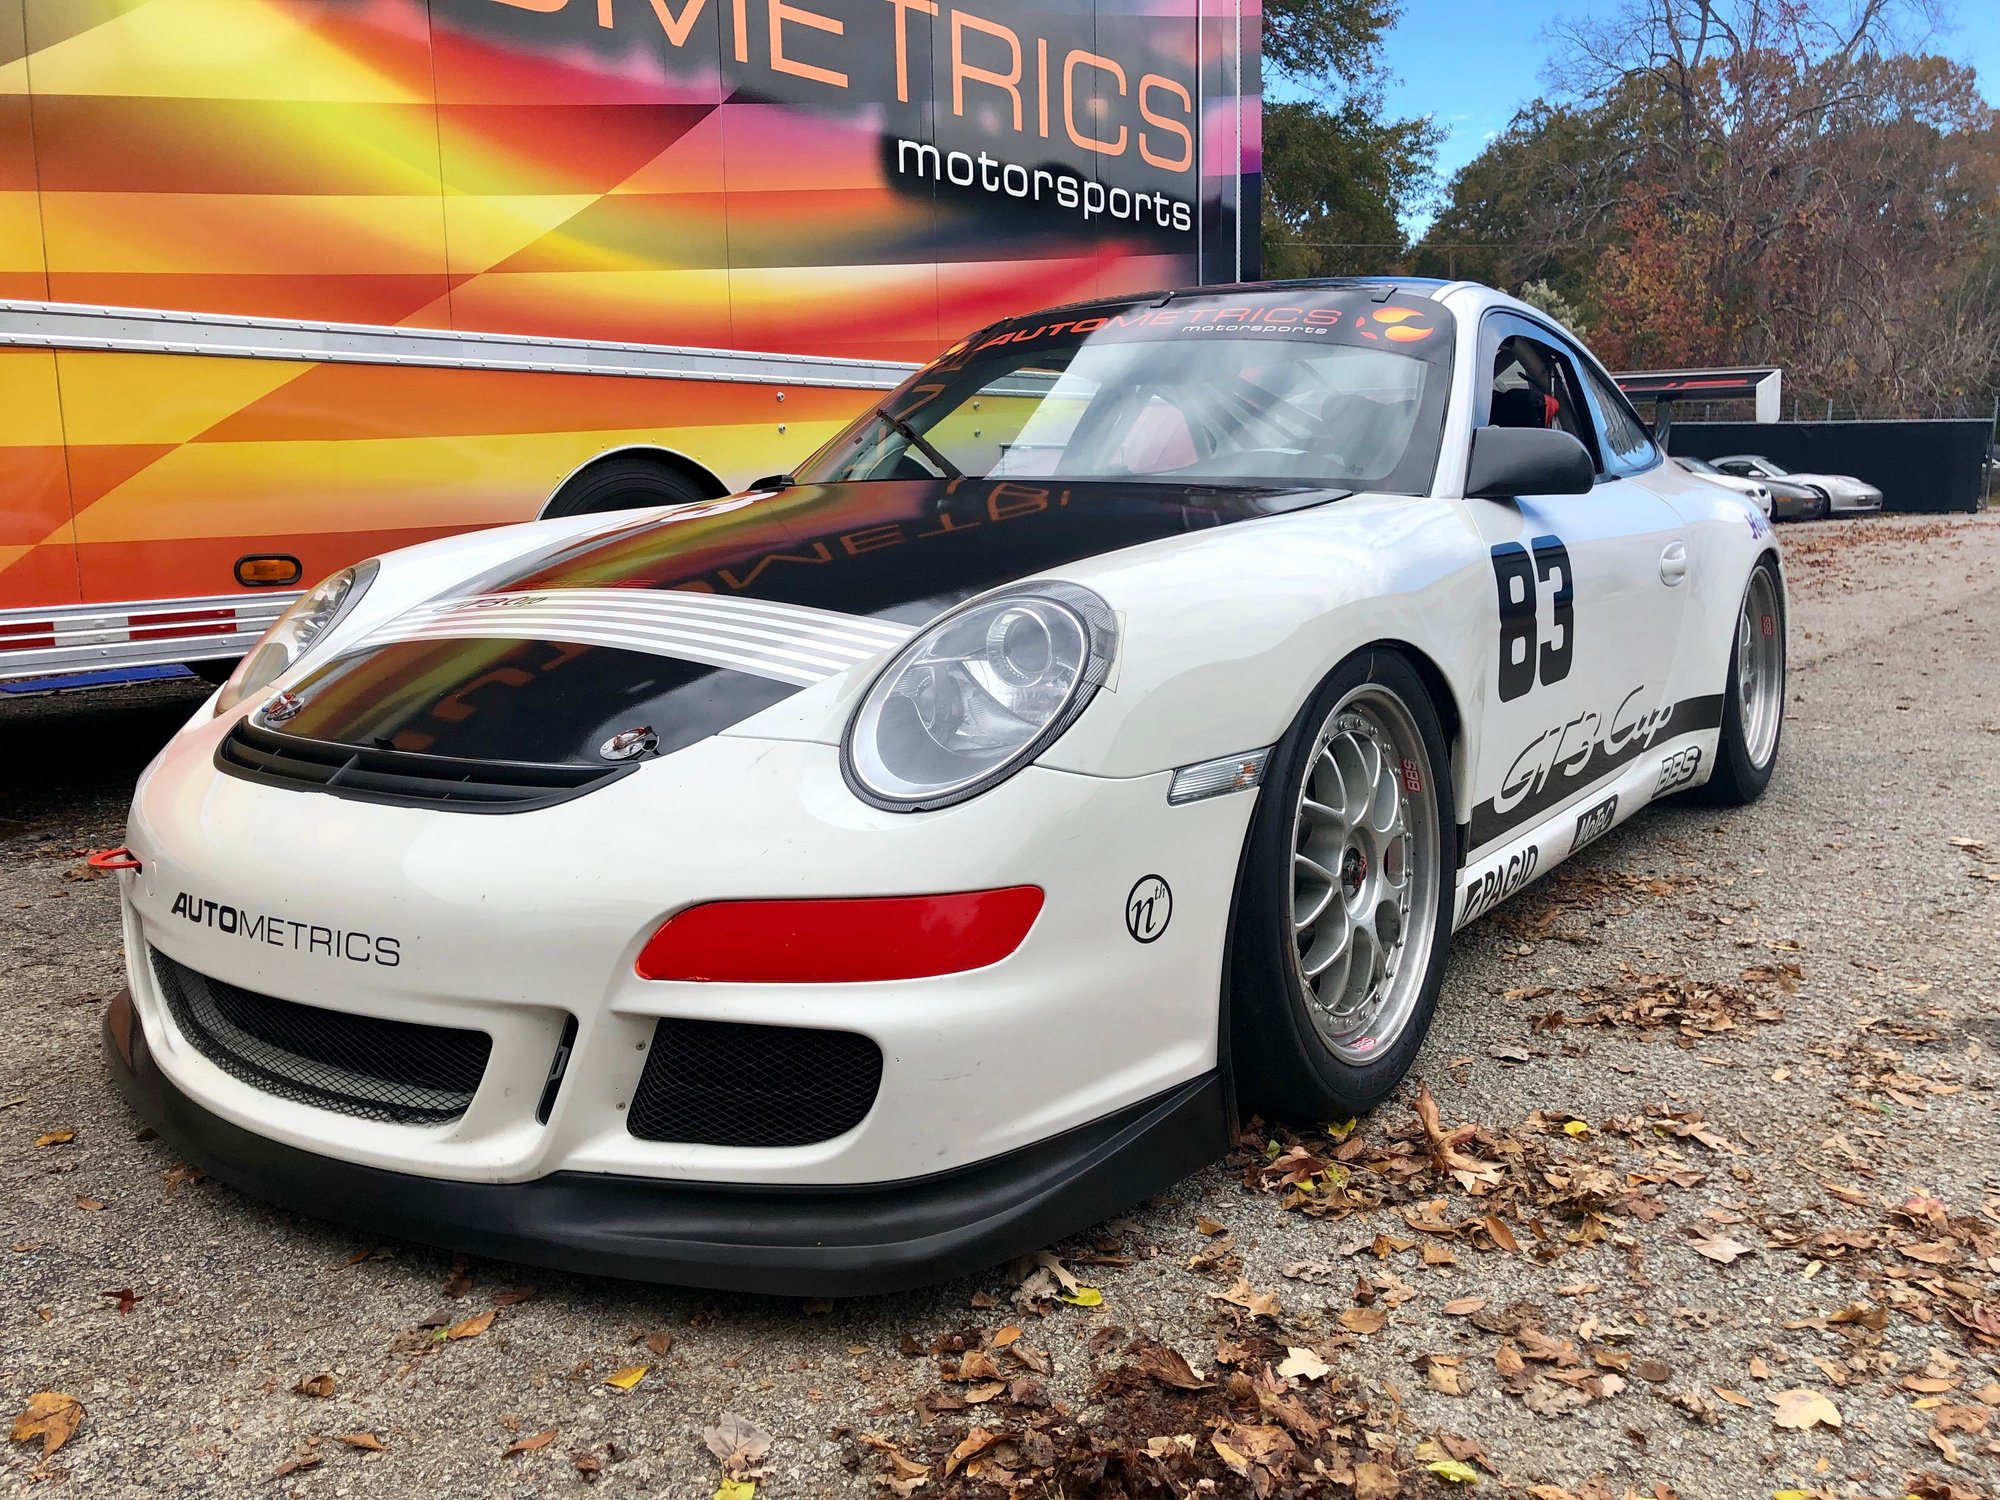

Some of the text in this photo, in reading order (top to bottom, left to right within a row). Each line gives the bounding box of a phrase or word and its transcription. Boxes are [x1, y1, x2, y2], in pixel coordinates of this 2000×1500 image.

[490, 0, 1193, 174] ETRICS
[897, 137, 1192, 231] motorsports
[974, 306, 1343, 350] AUTOMETRICS
[1180, 322, 1329, 336] motorsports
[1489, 534, 1575, 703] 83
[1403, 758, 1421, 792] BBS
[1494, 684, 1676, 814] GT3 Cup
[1651, 746, 1702, 799] BBS
[1484, 844, 1539, 909] PAGID
[171, 892, 400, 967] AUTOMETRICS
